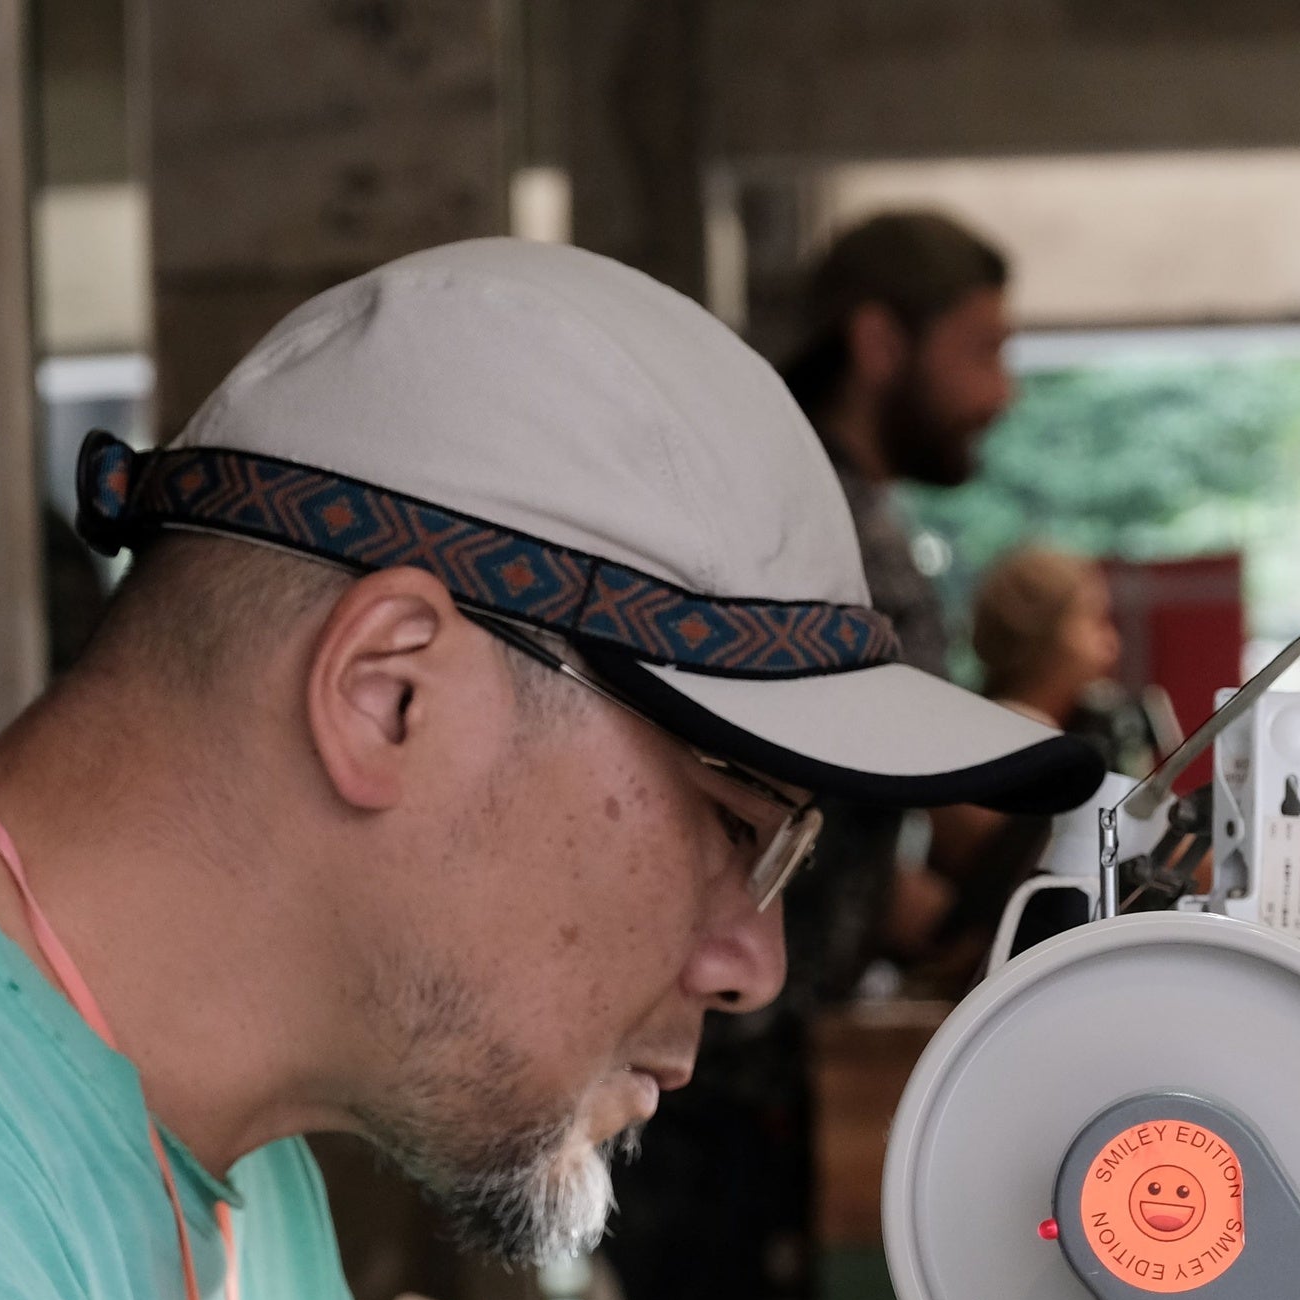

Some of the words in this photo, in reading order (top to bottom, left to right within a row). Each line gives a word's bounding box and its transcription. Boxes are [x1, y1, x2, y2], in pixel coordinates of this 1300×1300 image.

[1095, 1124, 1168, 1184] SMILEY
[1176, 1125, 1242, 1199] EDITION
[1091, 1211, 1166, 1281] EDITION
[1174, 1217, 1243, 1281] SMILEY
